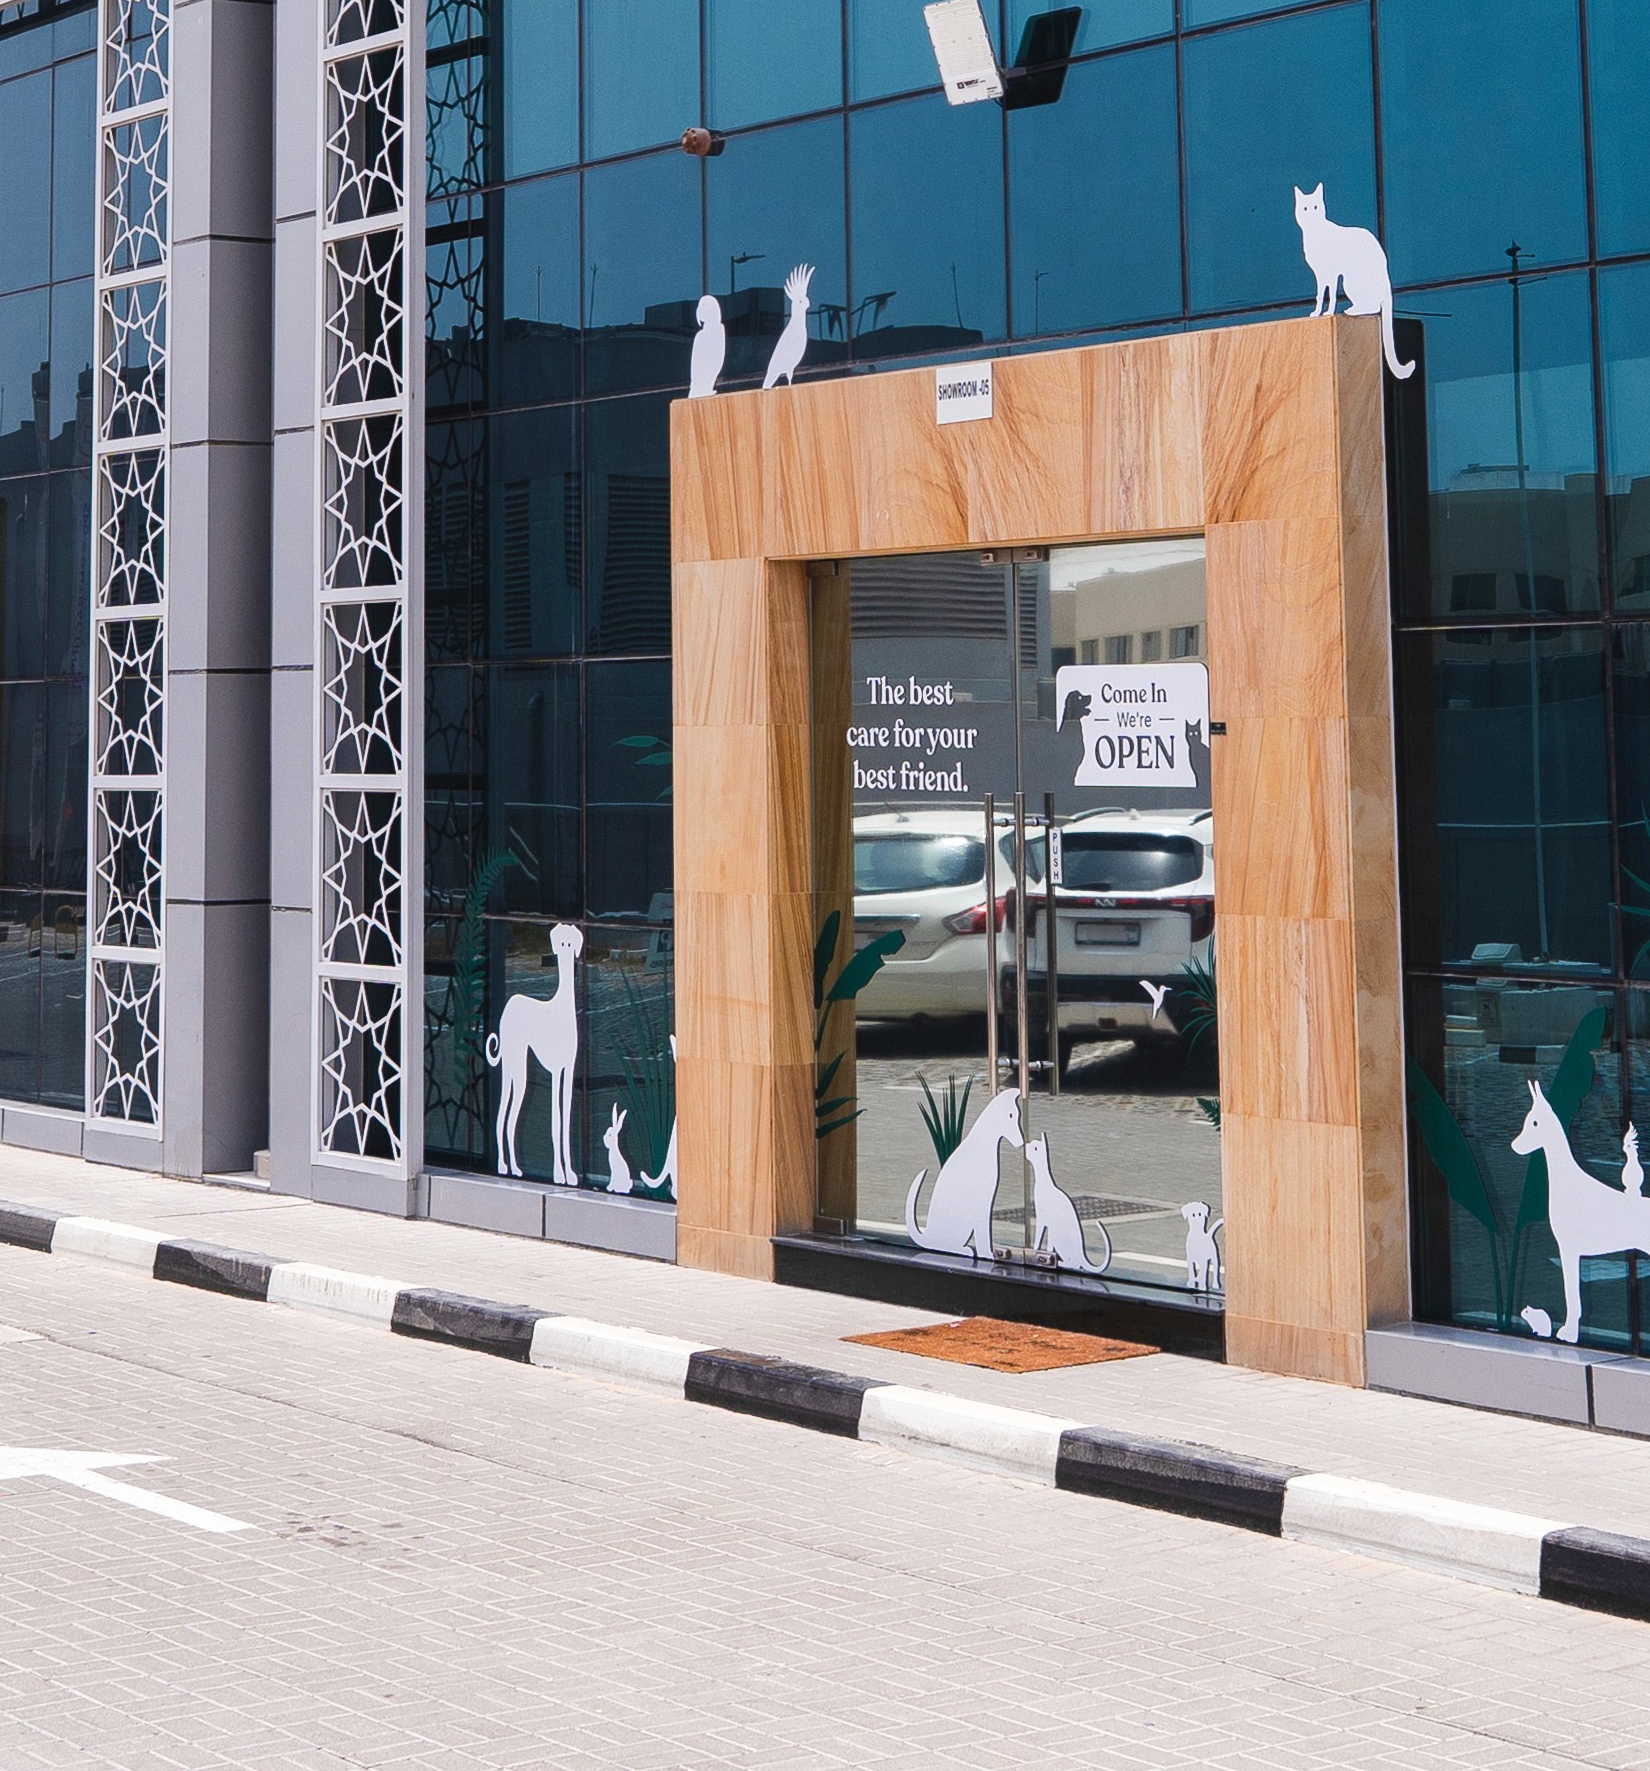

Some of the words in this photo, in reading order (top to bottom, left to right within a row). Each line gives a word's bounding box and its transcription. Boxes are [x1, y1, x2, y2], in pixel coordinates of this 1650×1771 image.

[938, 380, 978, 401] SHOWROOM
[866, 676, 905, 705] The
[909, 675, 954, 706] best
[1101, 683, 1147, 704] Come
[1151, 682, 1168, 703] In
[1116, 711, 1152, 728] We're
[846, 726, 890, 748] care
[893, 718, 925, 748] for
[925, 727, 978, 756] your
[1094, 735, 1175, 770] OPEN
[853, 759, 897, 790] best
[900, 761, 969, 792] friend.
[1052, 832, 1060, 881] PUSH
